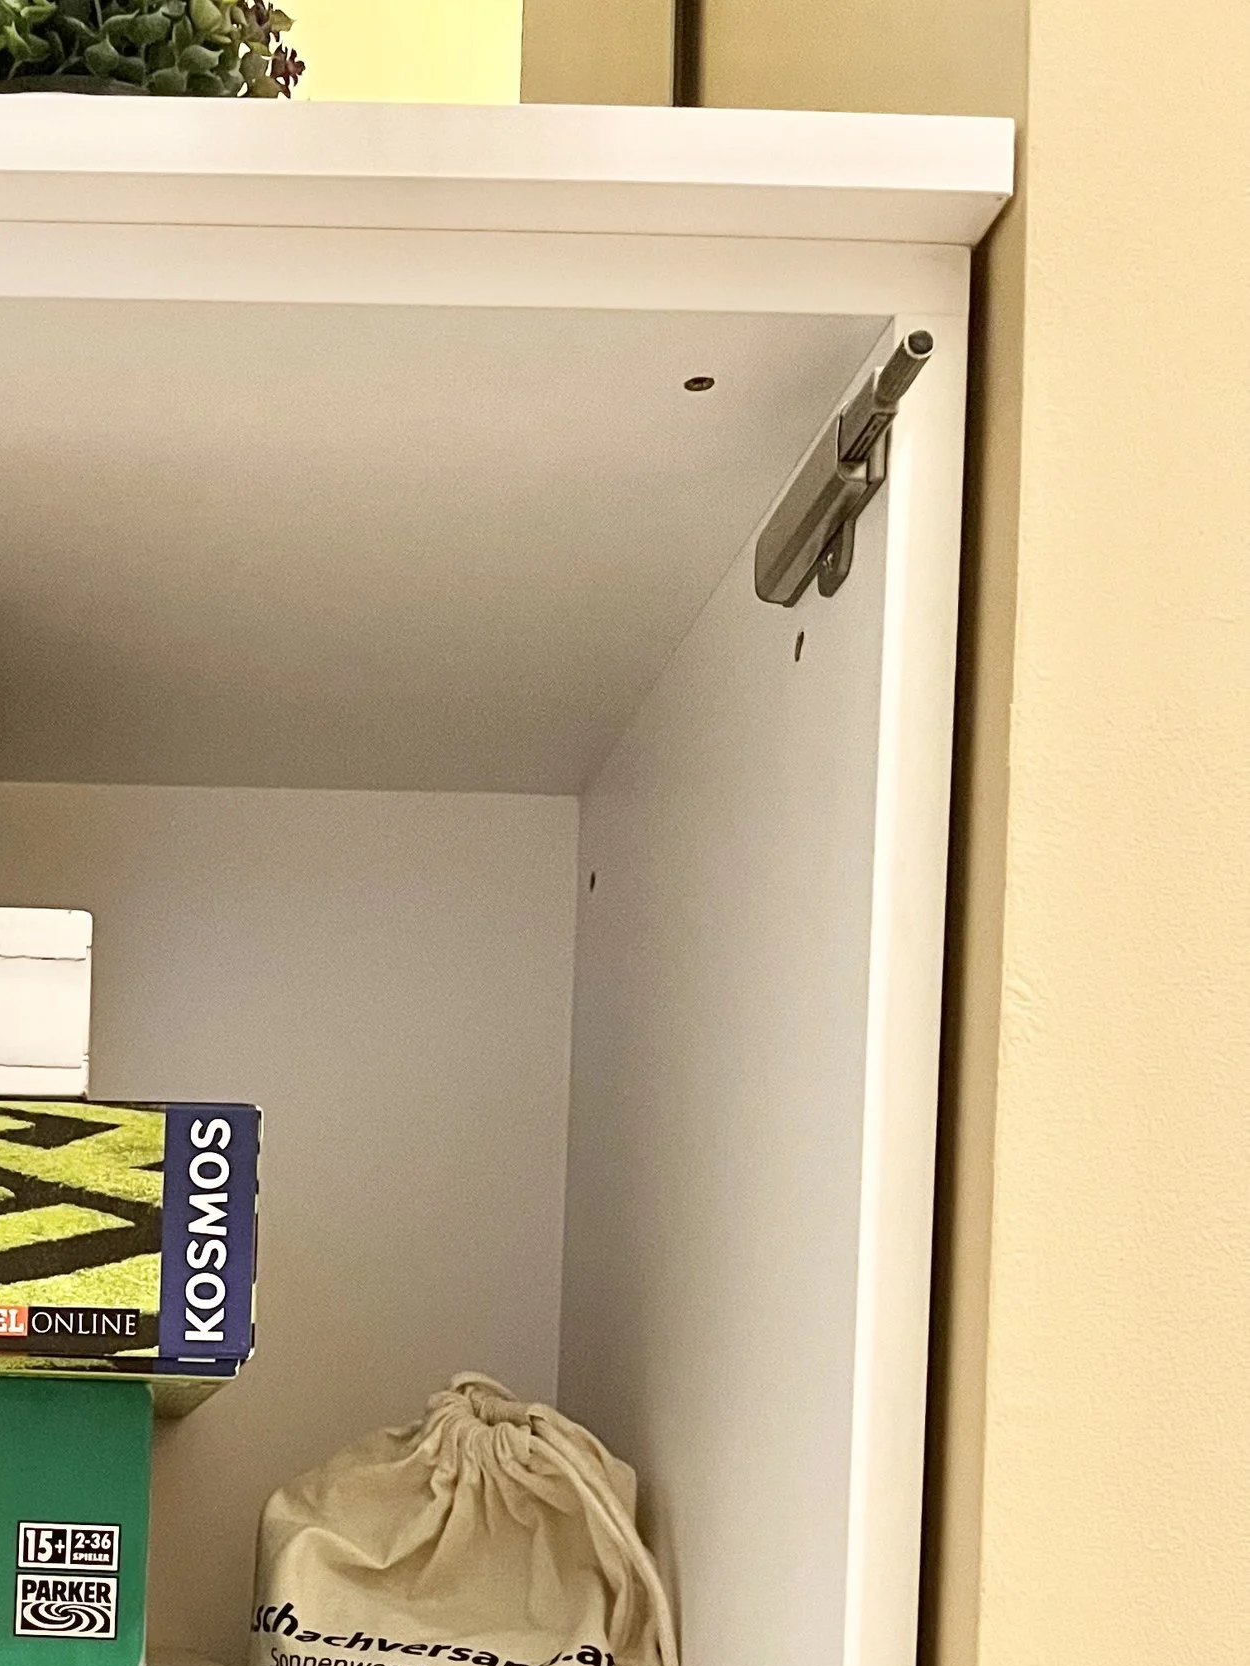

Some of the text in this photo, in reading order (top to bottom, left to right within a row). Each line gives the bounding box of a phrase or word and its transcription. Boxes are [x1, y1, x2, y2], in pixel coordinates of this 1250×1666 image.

[185, 1117, 232, 1342] KOSMOS
[30, 1311, 137, 1337] ONLINE
[25, 1529, 112, 1563] 15+ 2-36
[71, 1552, 110, 1562] SPIELER
[21, 1579, 112, 1604] PARKER
